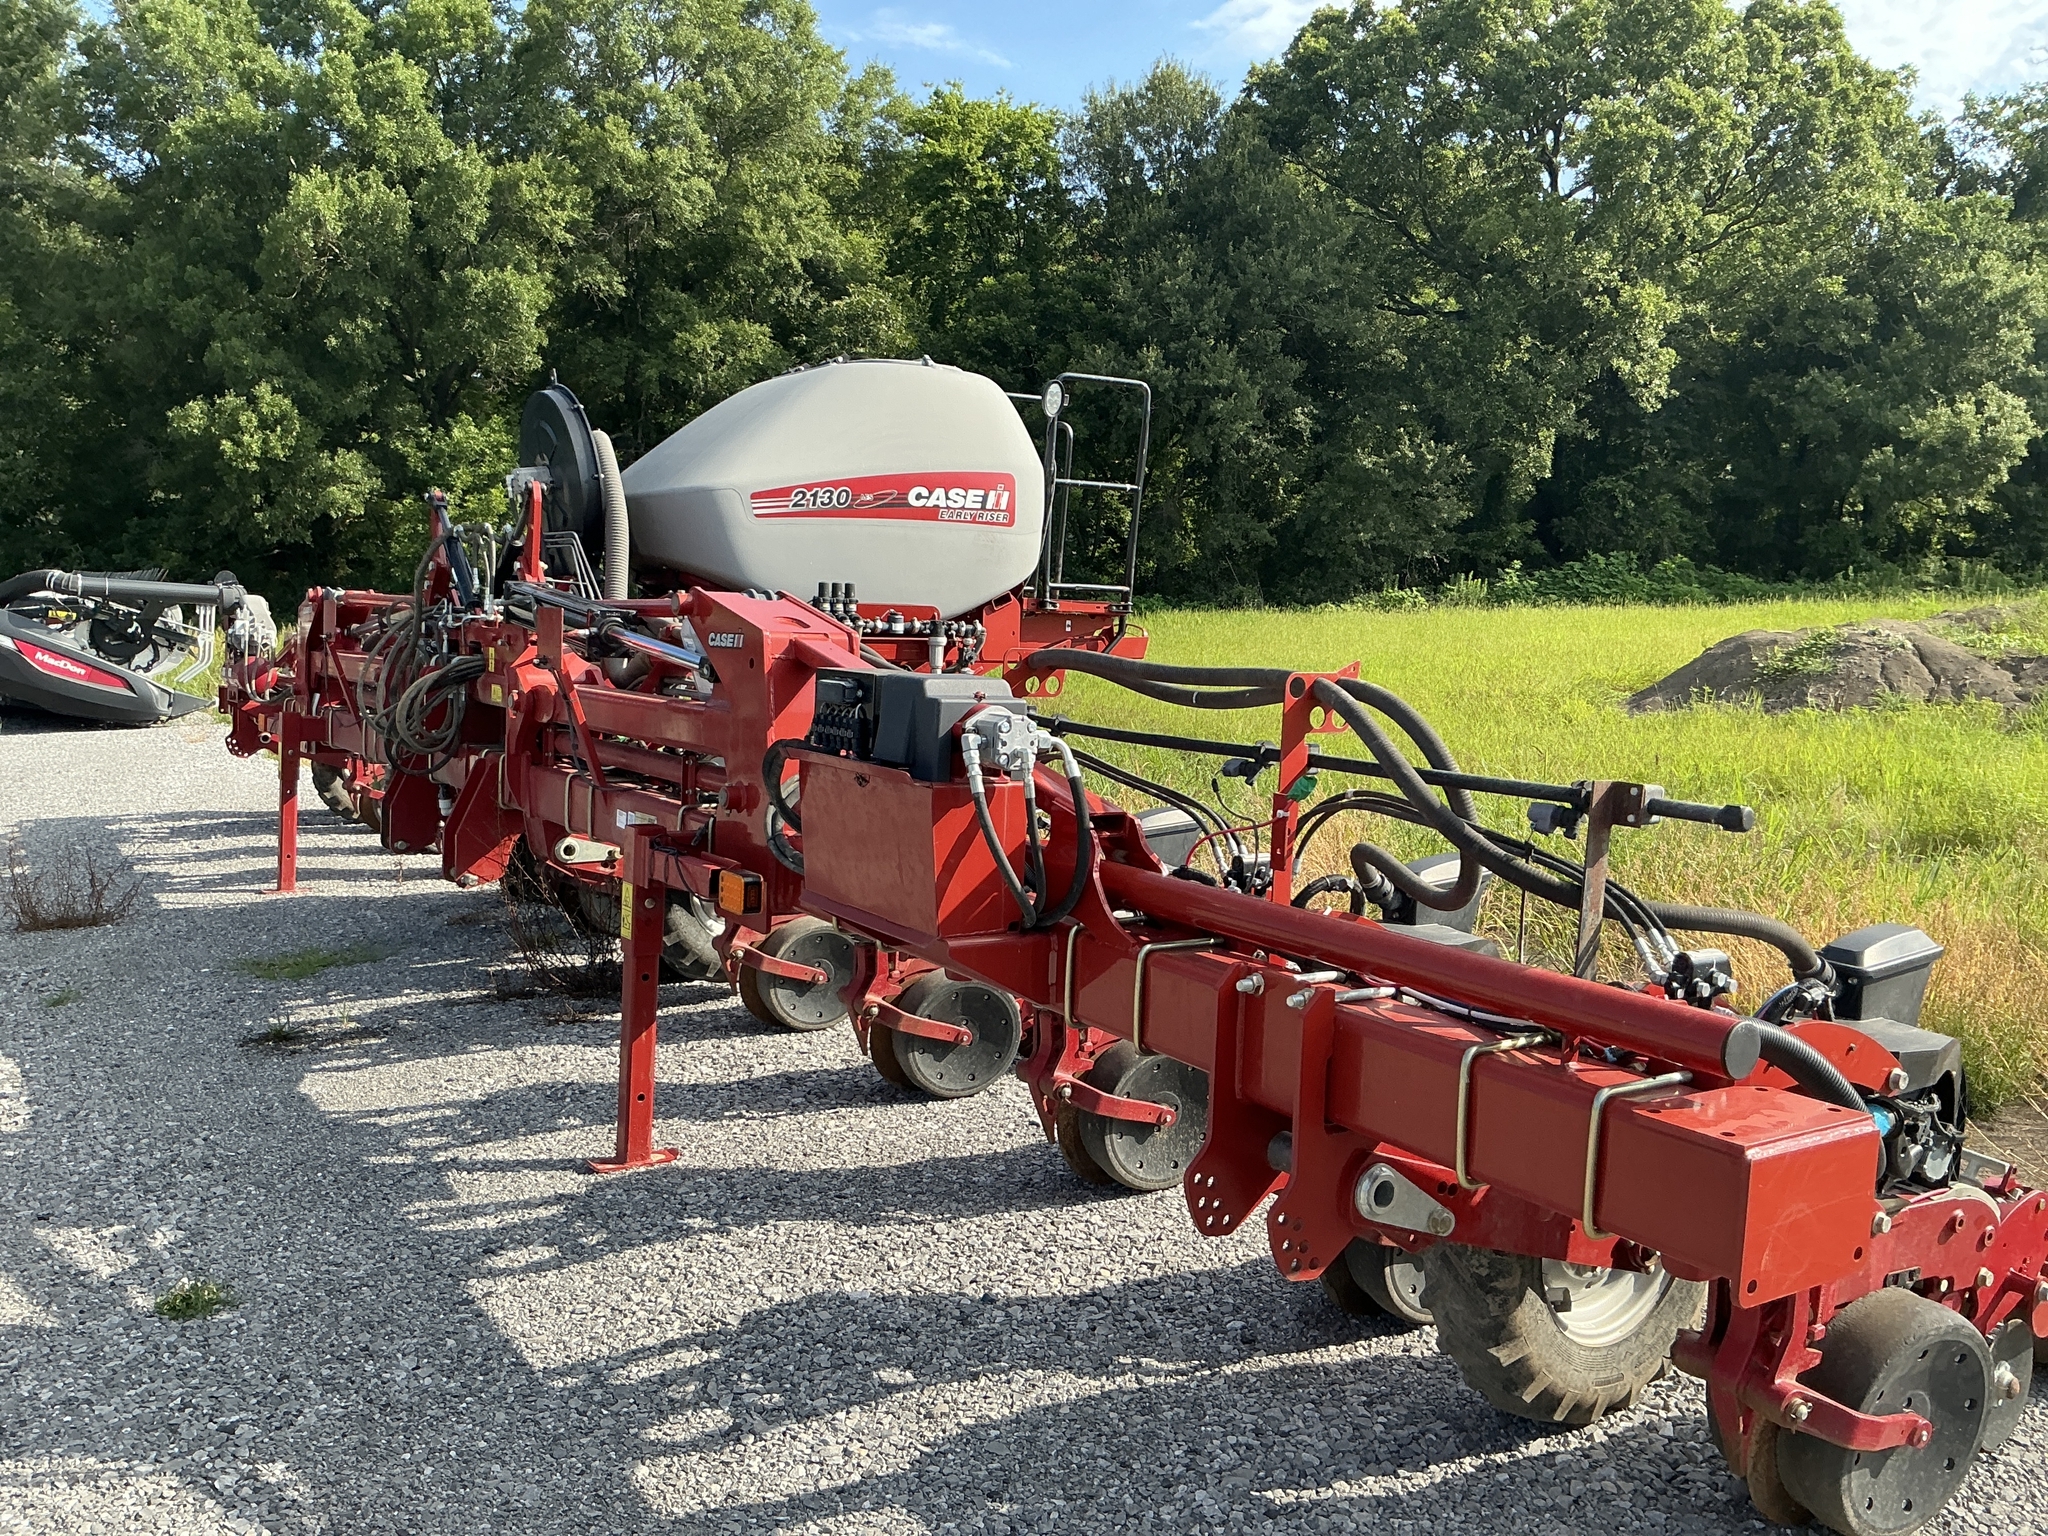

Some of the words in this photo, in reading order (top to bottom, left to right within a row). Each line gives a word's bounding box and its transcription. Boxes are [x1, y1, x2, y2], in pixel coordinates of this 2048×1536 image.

[789, 486, 852, 509] 2130
[907, 486, 985, 509] CASE
[938, 509, 976, 521] EARLY
[976, 511, 1010, 523] RISER
[708, 632, 734, 647] CASE
[34, 651, 87, 676] MacDon
